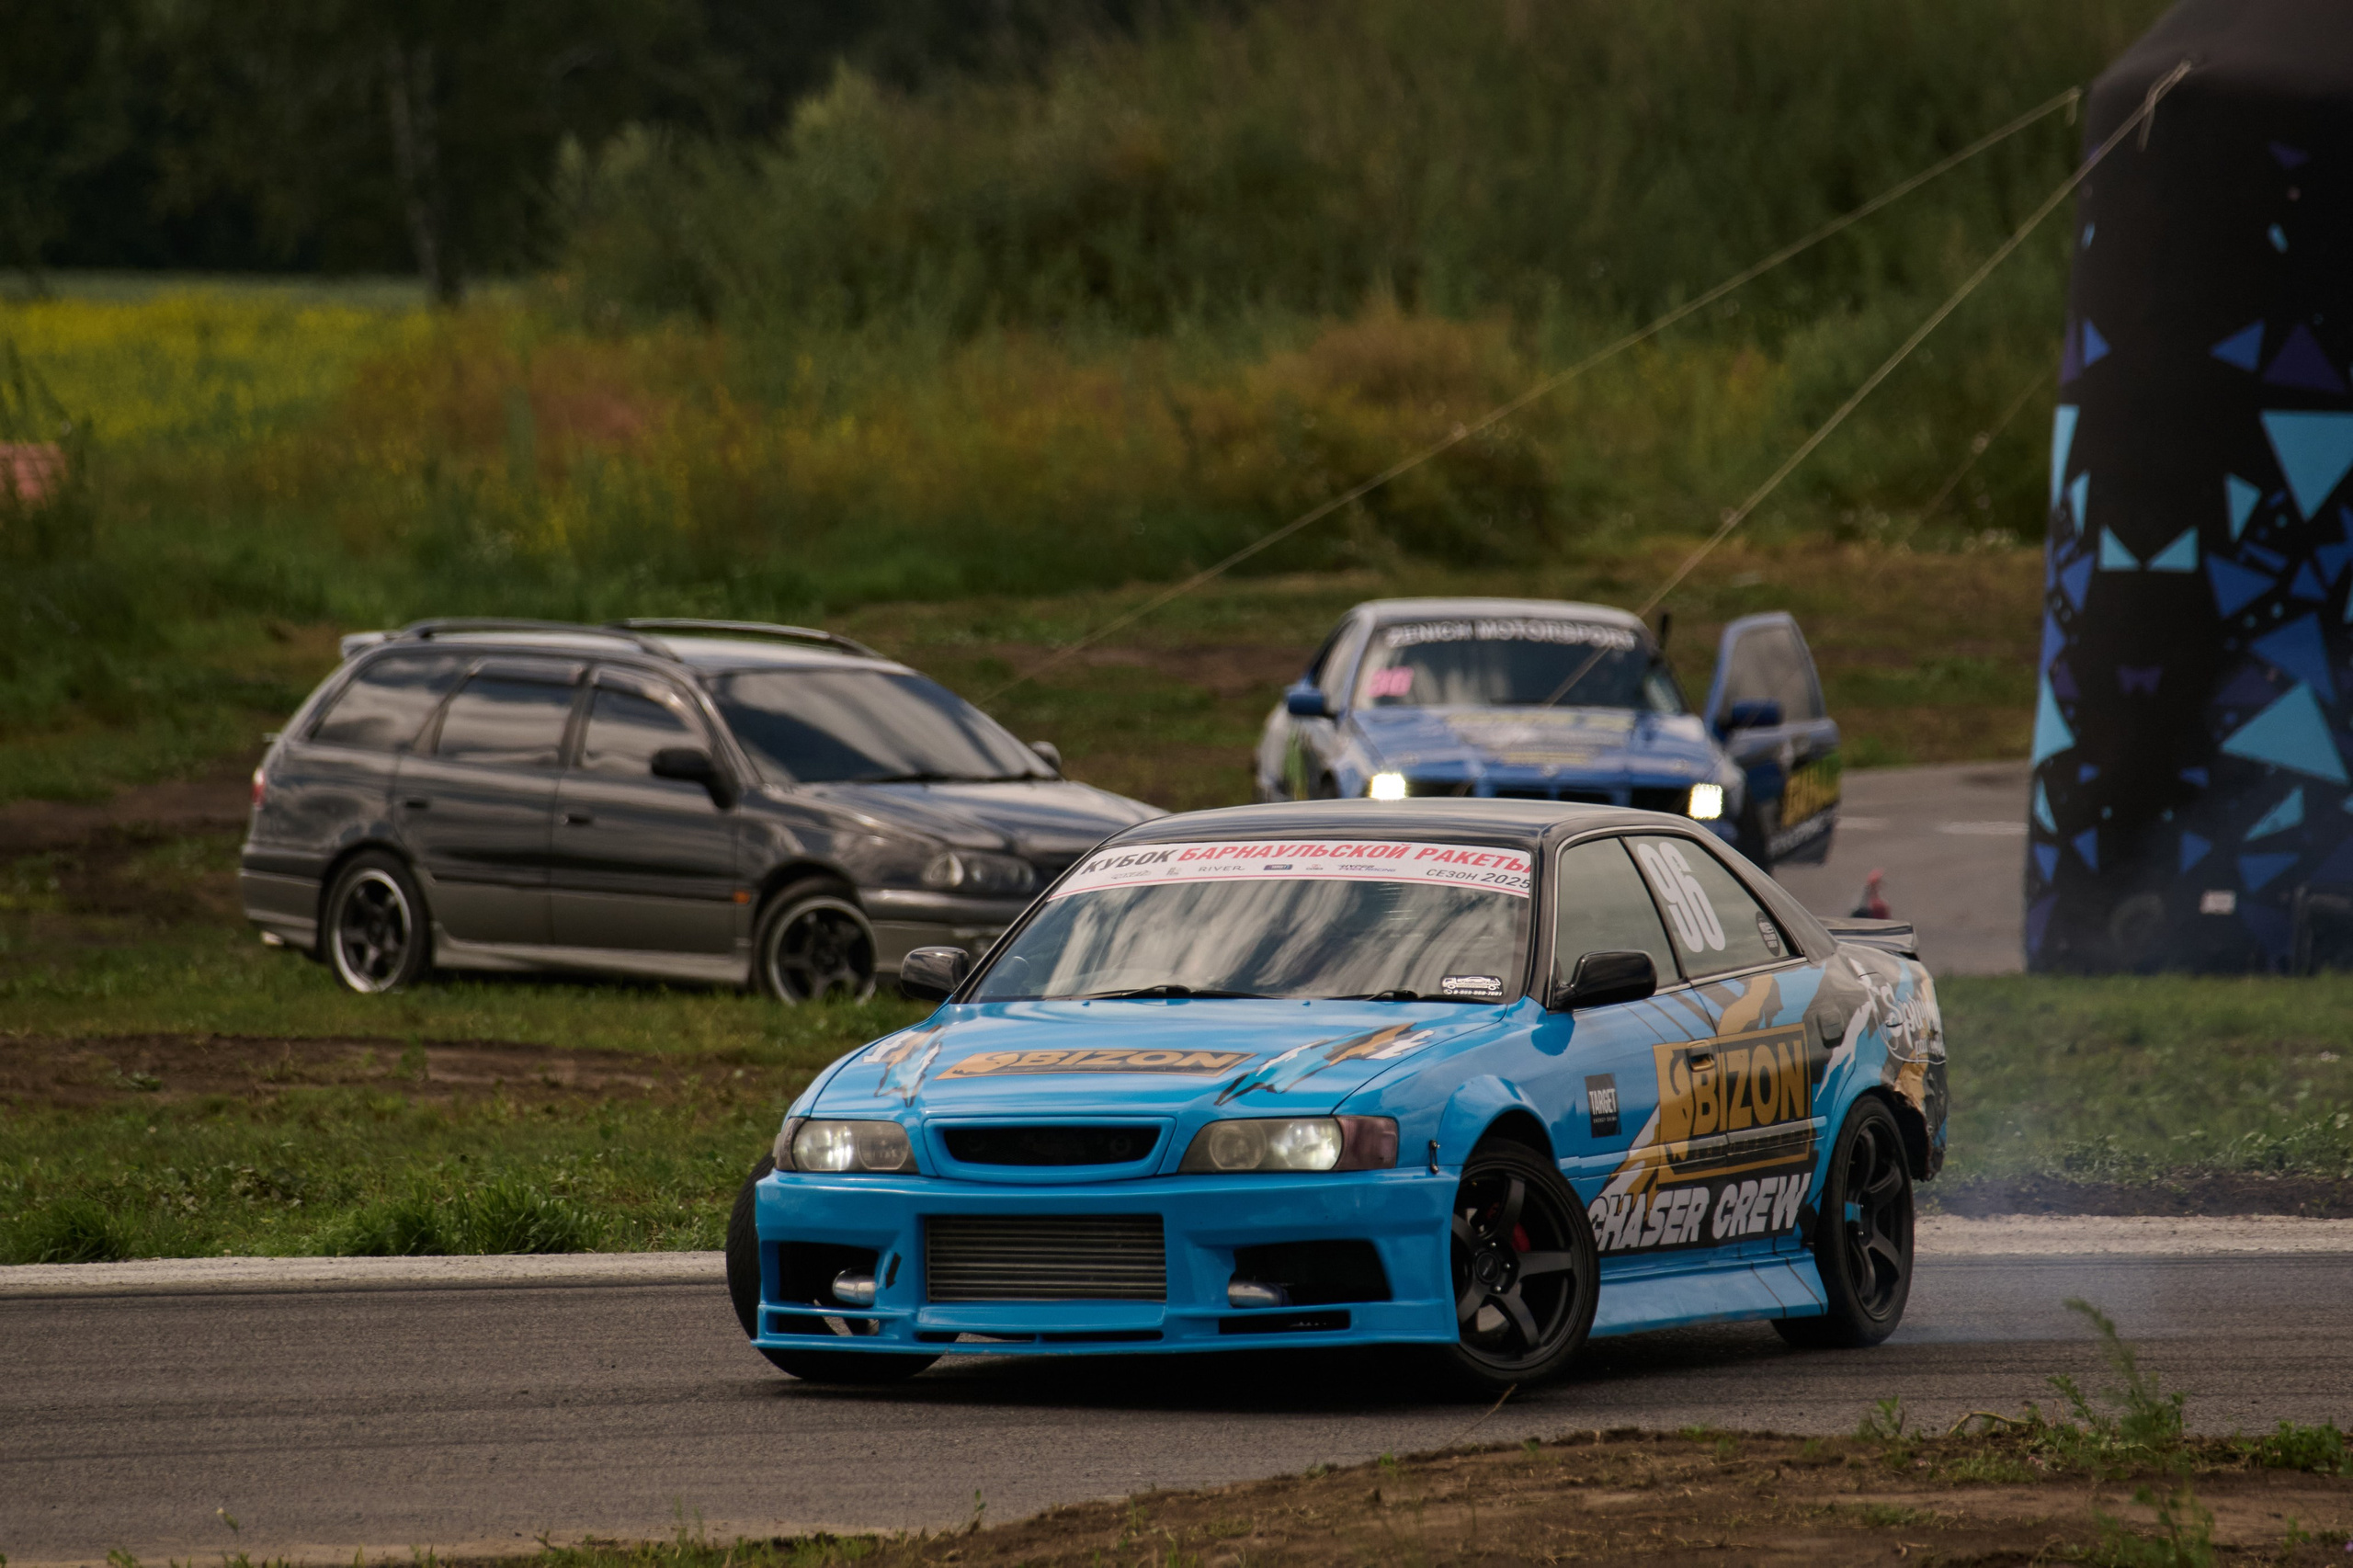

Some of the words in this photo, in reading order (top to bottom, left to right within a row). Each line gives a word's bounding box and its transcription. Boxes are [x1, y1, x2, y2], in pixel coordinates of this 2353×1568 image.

[1473, 619, 1636, 652] MOTORSPORT
[1081, 848, 1180, 875] КУБОК
[1177, 843, 1413, 862] БАРНАУЛЬСКОЙ
[1414, 846, 1531, 874] РАКЕТЫ
[1426, 869, 1479, 881] СЕЗОН
[1481, 872, 1531, 889] 2025
[1637, 841, 1726, 953] 96
[1014, 1051, 1240, 1069] BIZON
[1588, 1088, 1618, 1116] TARGET
[1691, 1040, 1805, 1136] BIZON
[1587, 1187, 1711, 1252] CHASER
[1711, 1172, 1813, 1240] CREW
